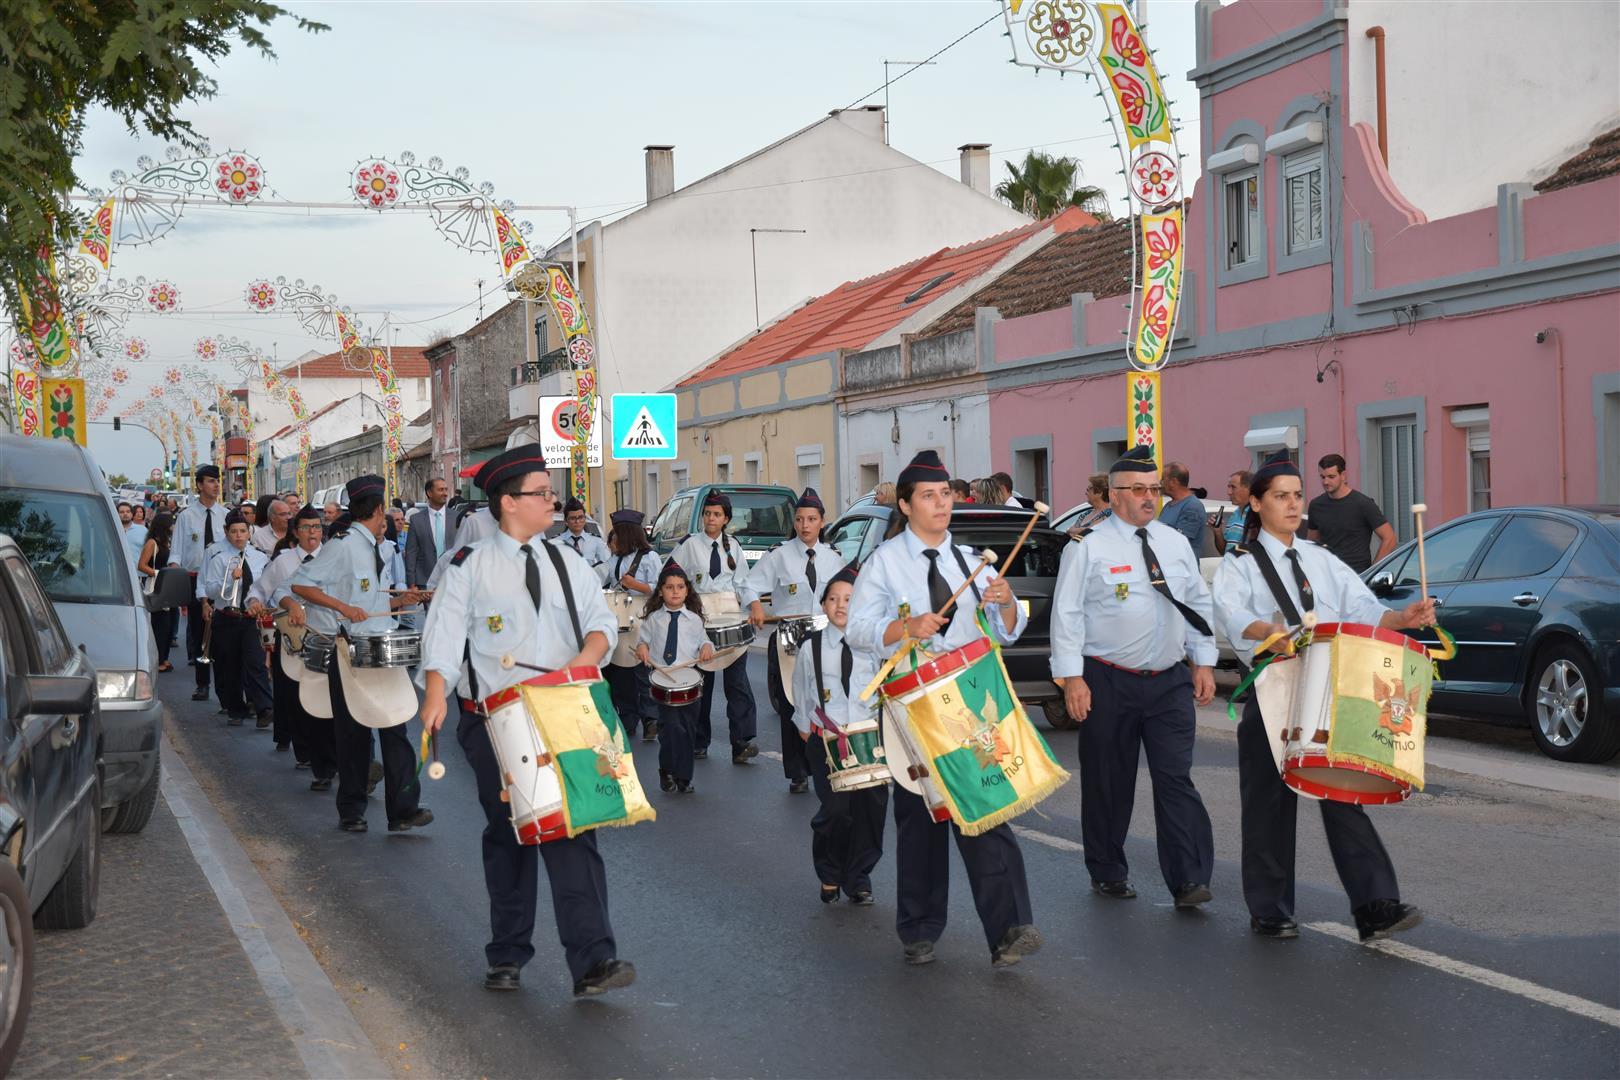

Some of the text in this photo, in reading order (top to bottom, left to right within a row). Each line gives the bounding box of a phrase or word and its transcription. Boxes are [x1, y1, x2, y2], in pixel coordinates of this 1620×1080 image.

[545, 443, 599, 453] velocde
[544, 455, 599, 465] contrda
[1371, 729, 1416, 751] MONTIJO
[981, 755, 1024, 788] MONTIJO
[595, 780, 635, 796] MONTIJO
